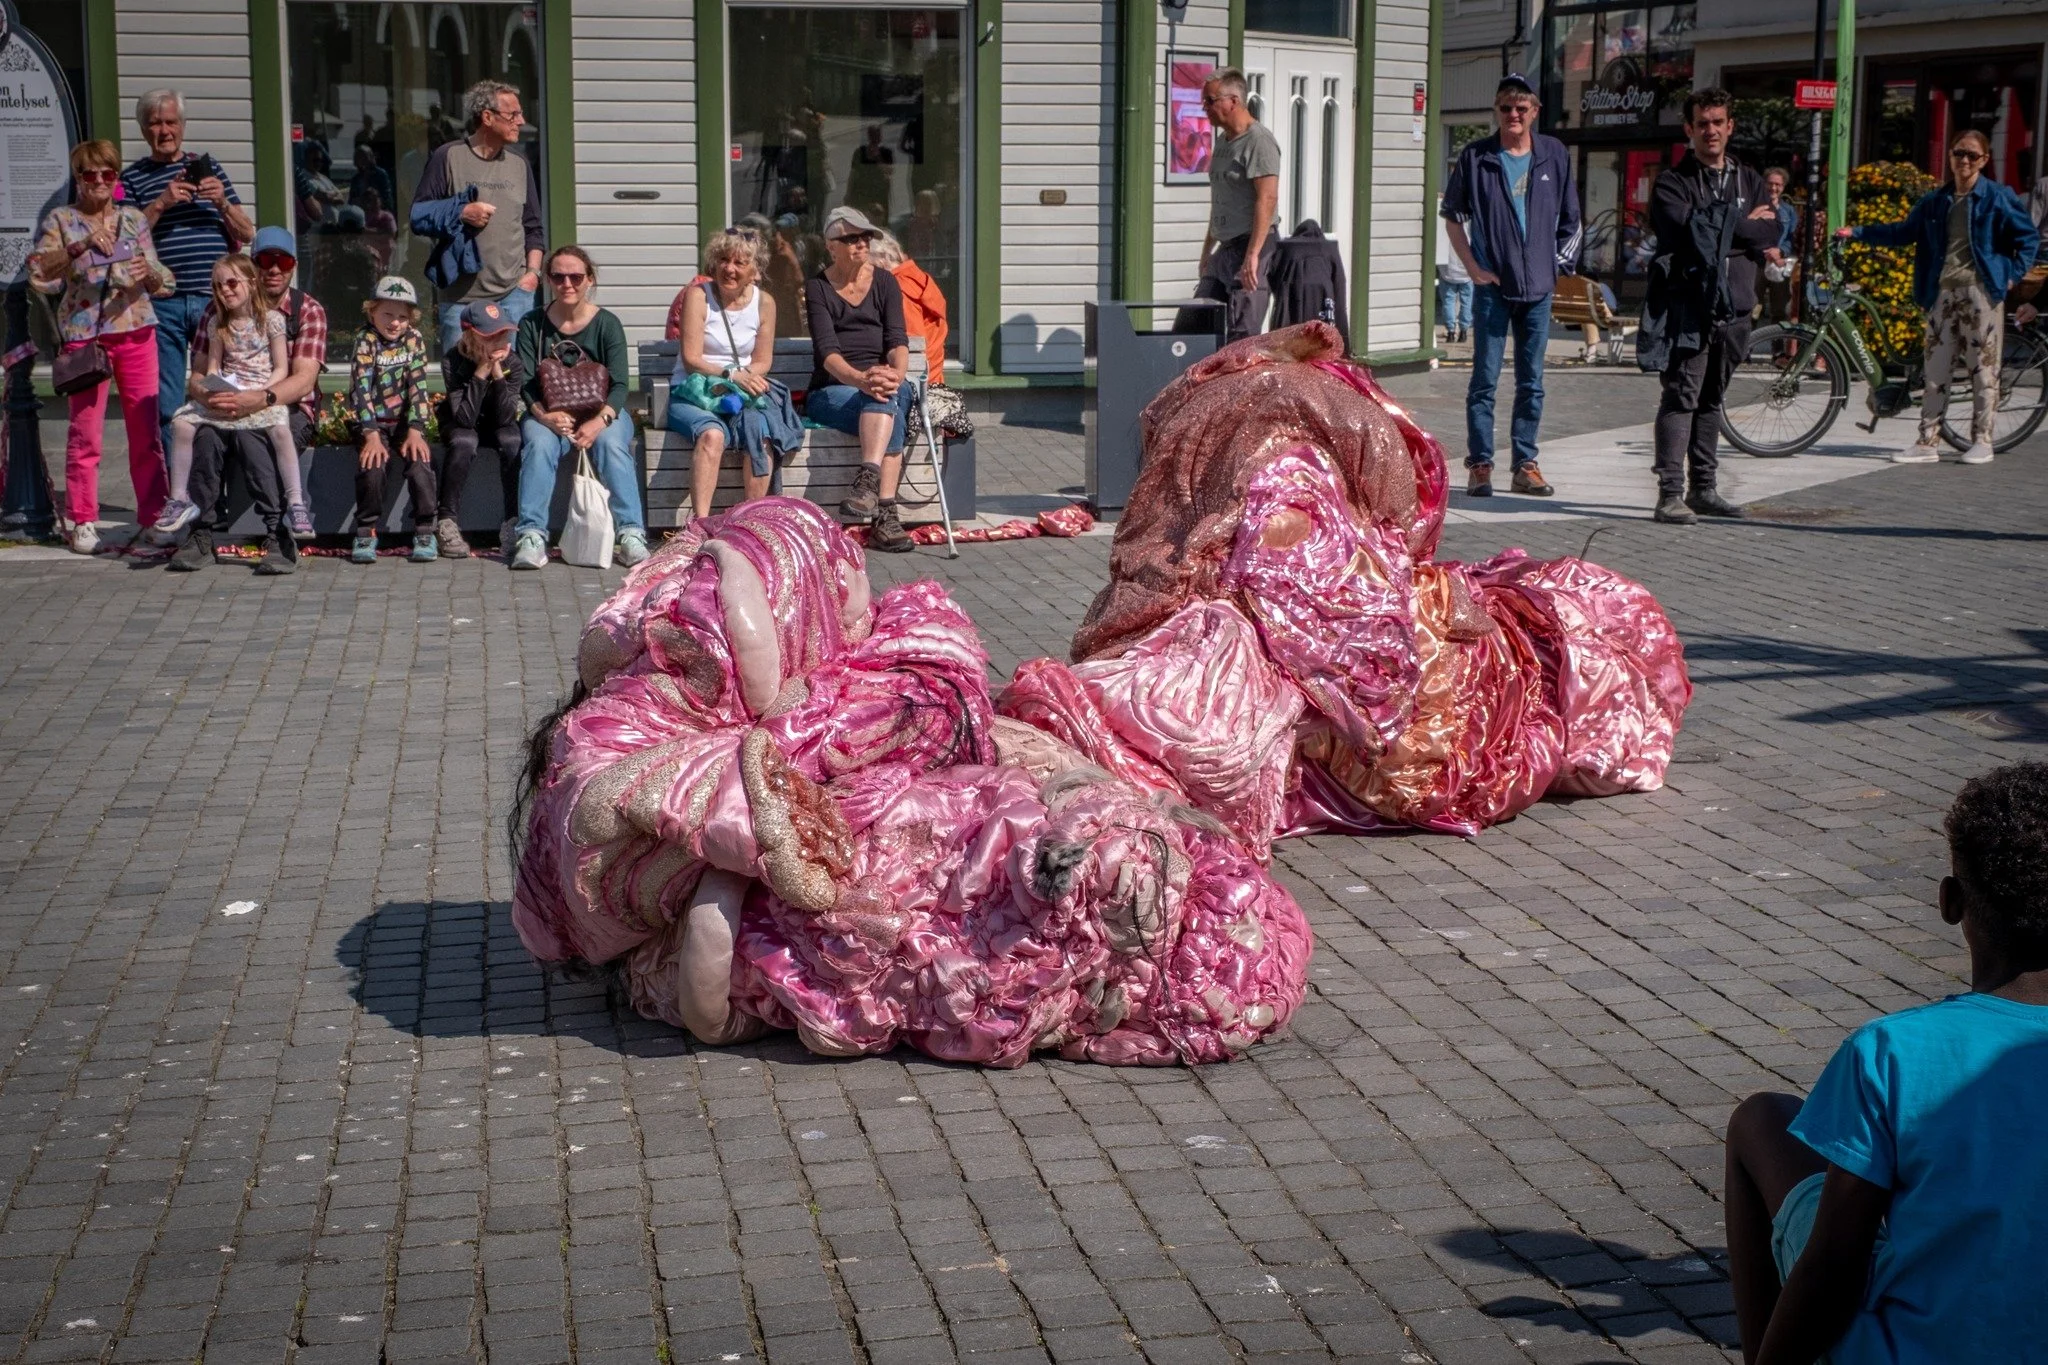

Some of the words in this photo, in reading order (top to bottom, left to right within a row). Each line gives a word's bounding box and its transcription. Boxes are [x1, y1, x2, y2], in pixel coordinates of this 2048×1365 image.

[1580, 84, 1621, 112] Tattoo
[1620, 84, 1655, 113] Shop
[1851, 329, 1875, 375] townie
